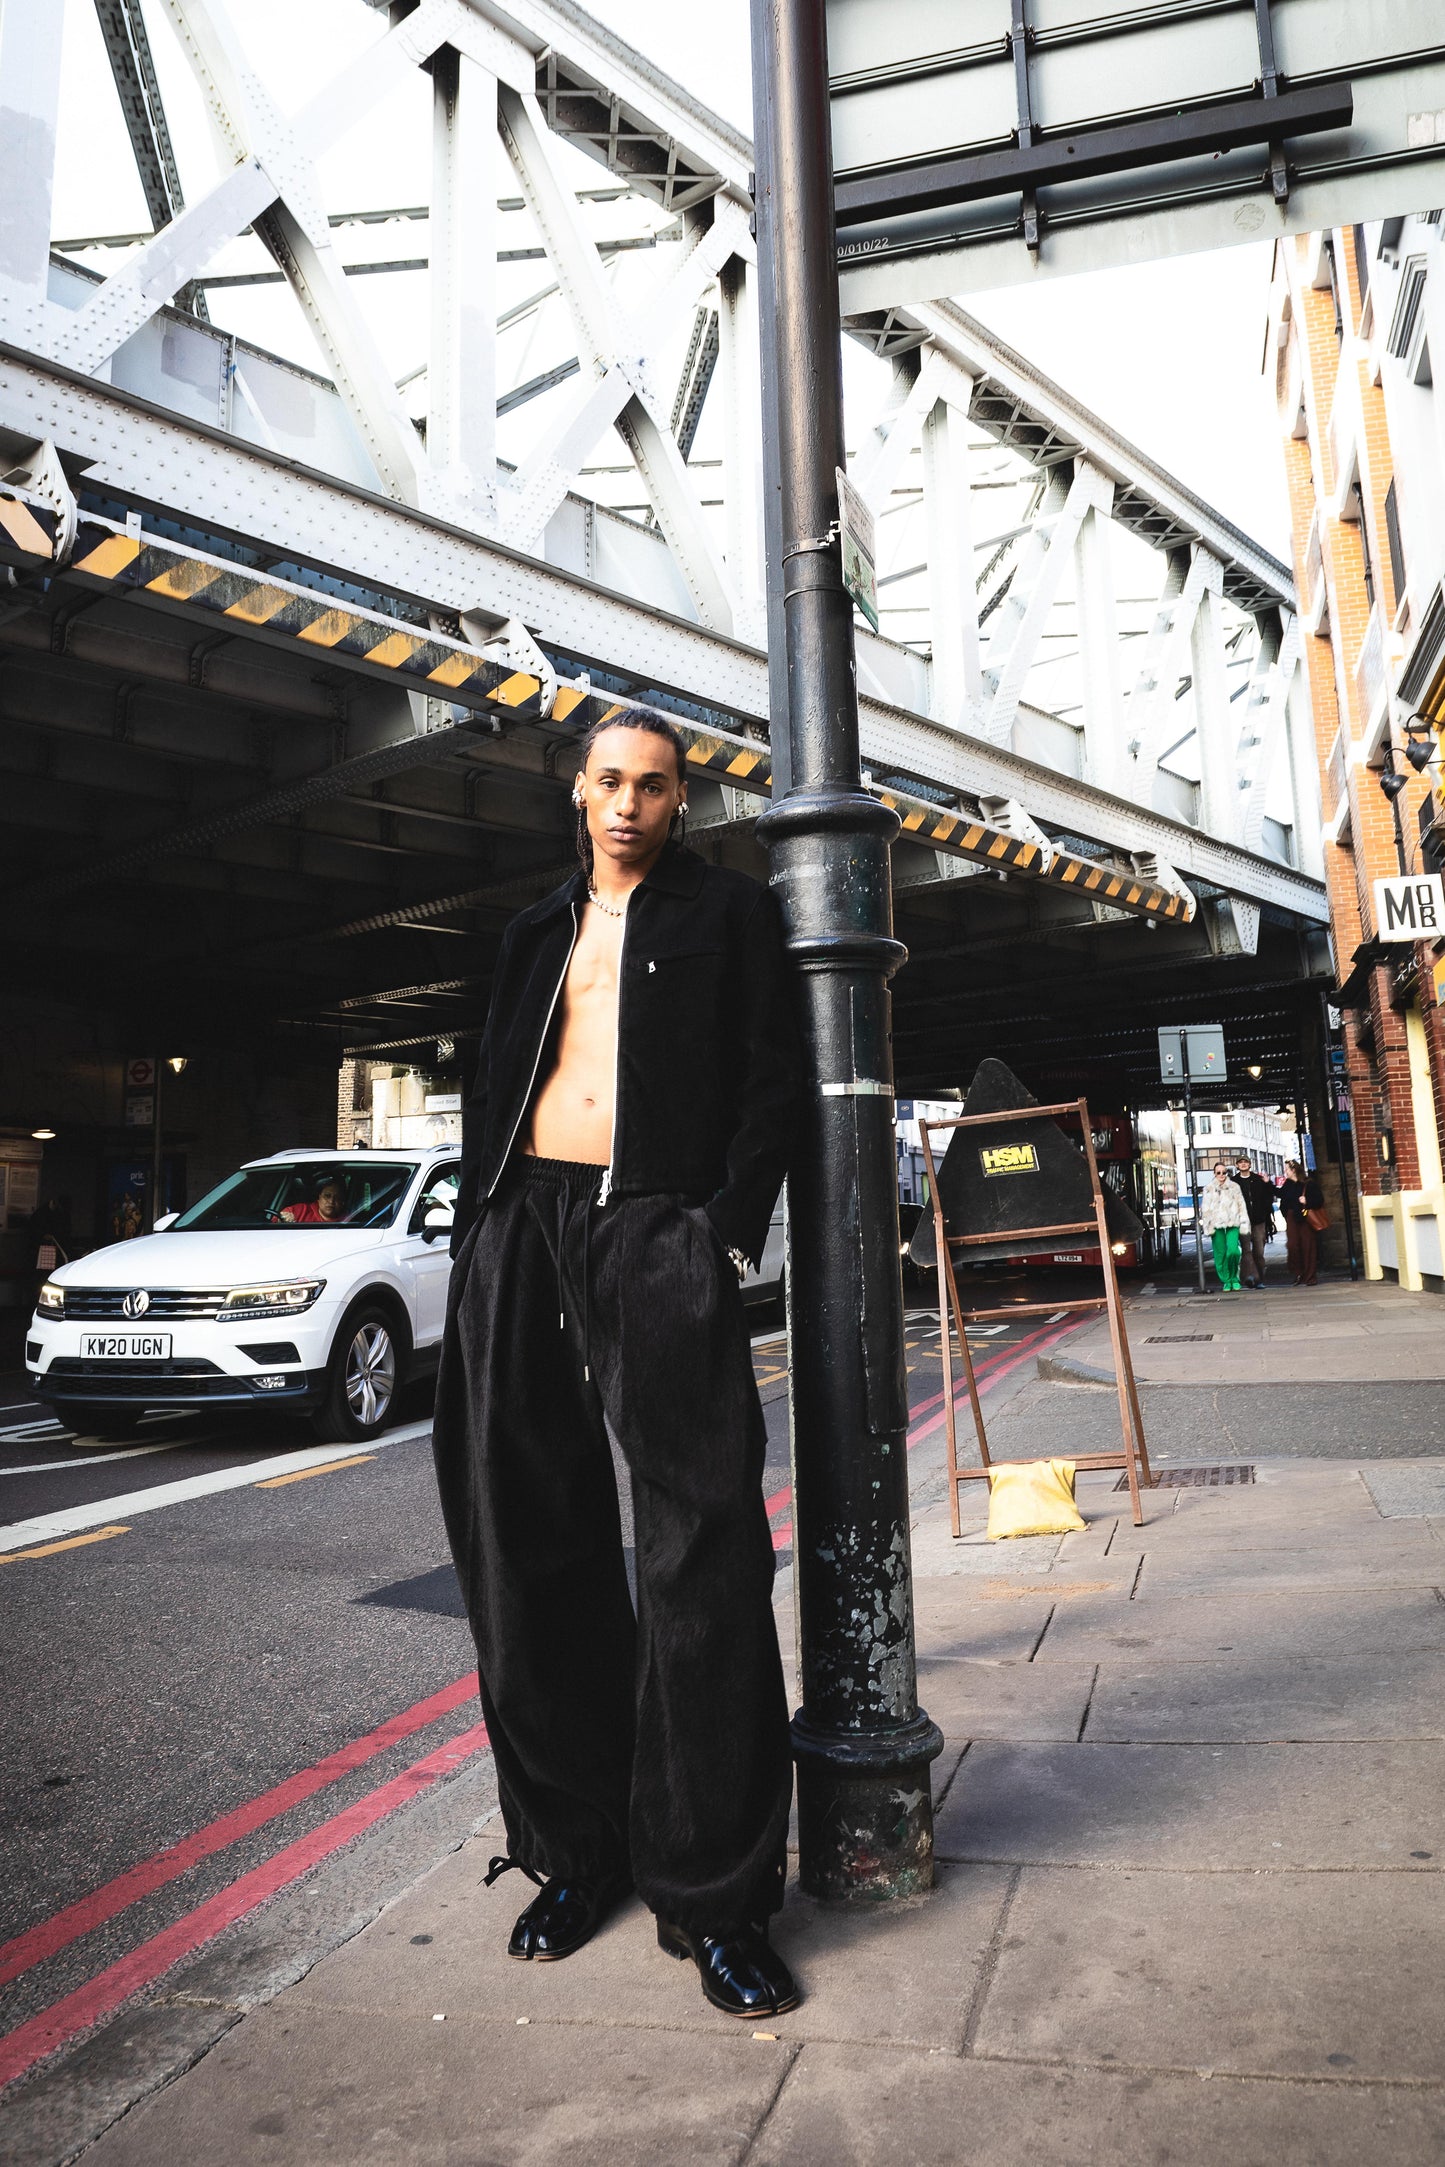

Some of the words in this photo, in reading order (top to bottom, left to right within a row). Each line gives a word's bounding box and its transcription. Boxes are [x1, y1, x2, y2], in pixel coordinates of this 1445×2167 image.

[982, 1145, 1034, 1168] HSM
[87, 1338, 127, 1356] KW20
[131, 1338, 163, 1356] UGN
